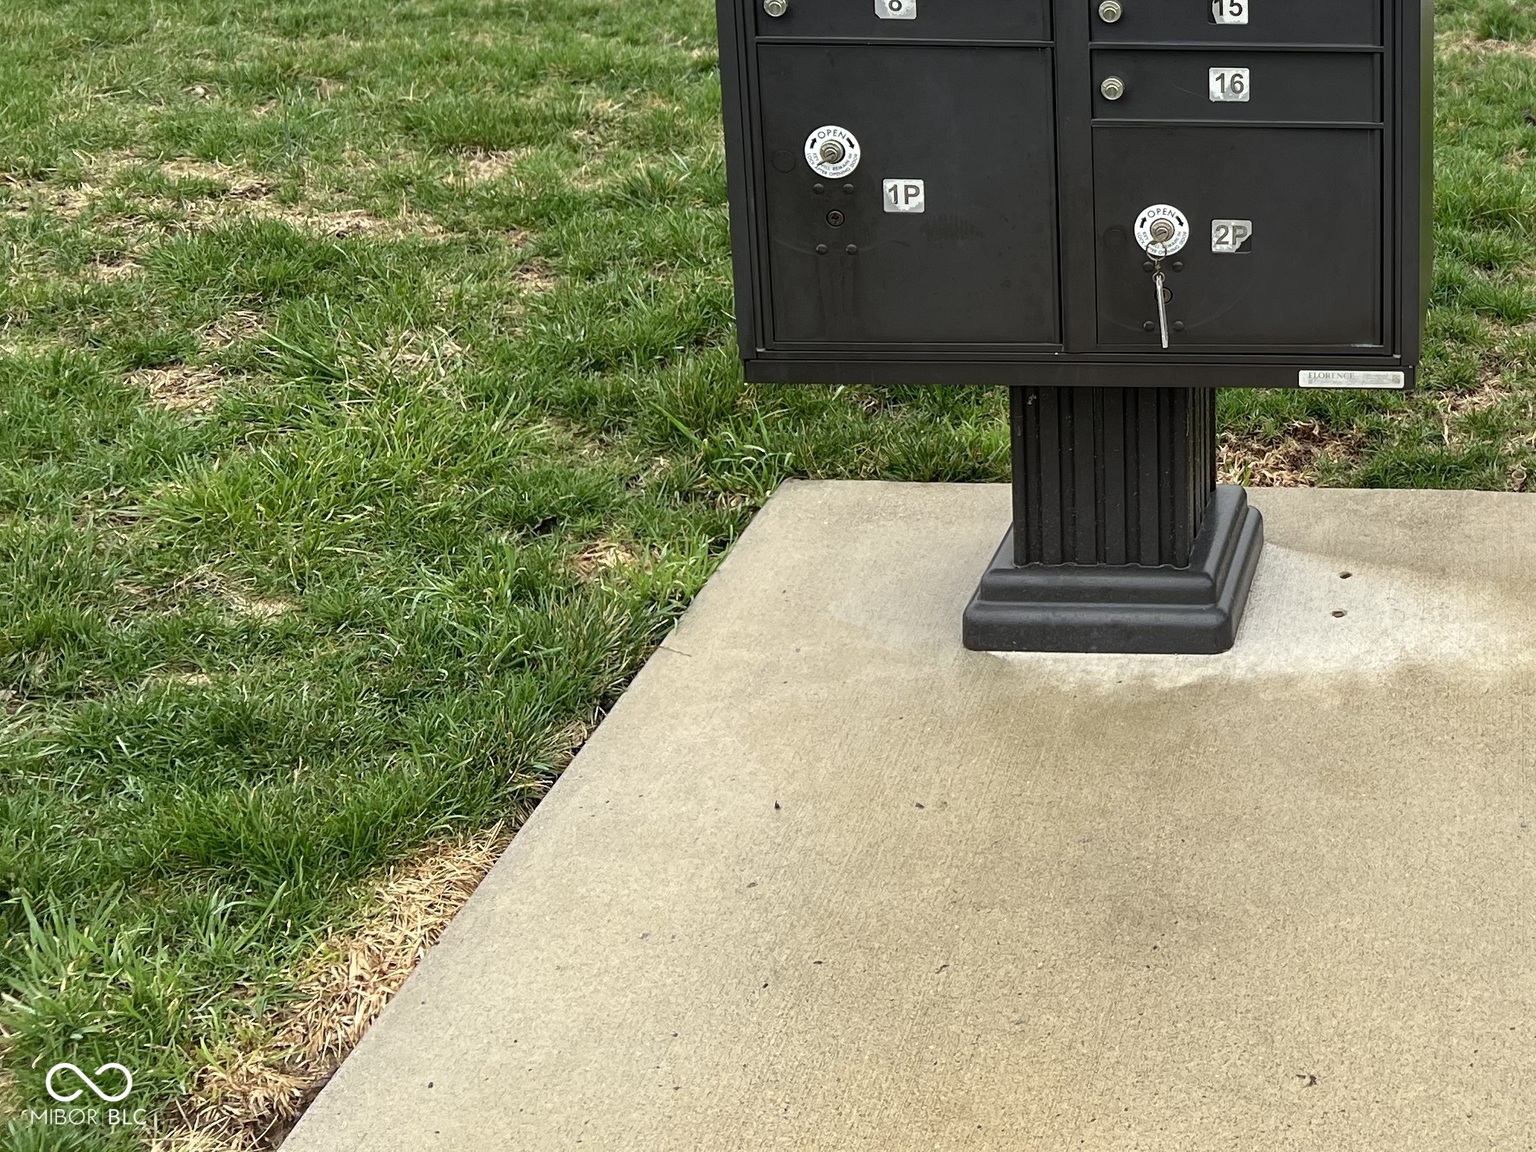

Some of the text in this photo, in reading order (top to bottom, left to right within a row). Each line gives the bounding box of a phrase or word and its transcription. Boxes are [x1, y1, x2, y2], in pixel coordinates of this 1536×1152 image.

[1215, 73, 1244, 94] 16
[817, 129, 847, 139] OPEN
[888, 184, 920, 205] 1P
[1147, 208, 1177, 218] OPEN
[1215, 225, 1248, 246] 2P
